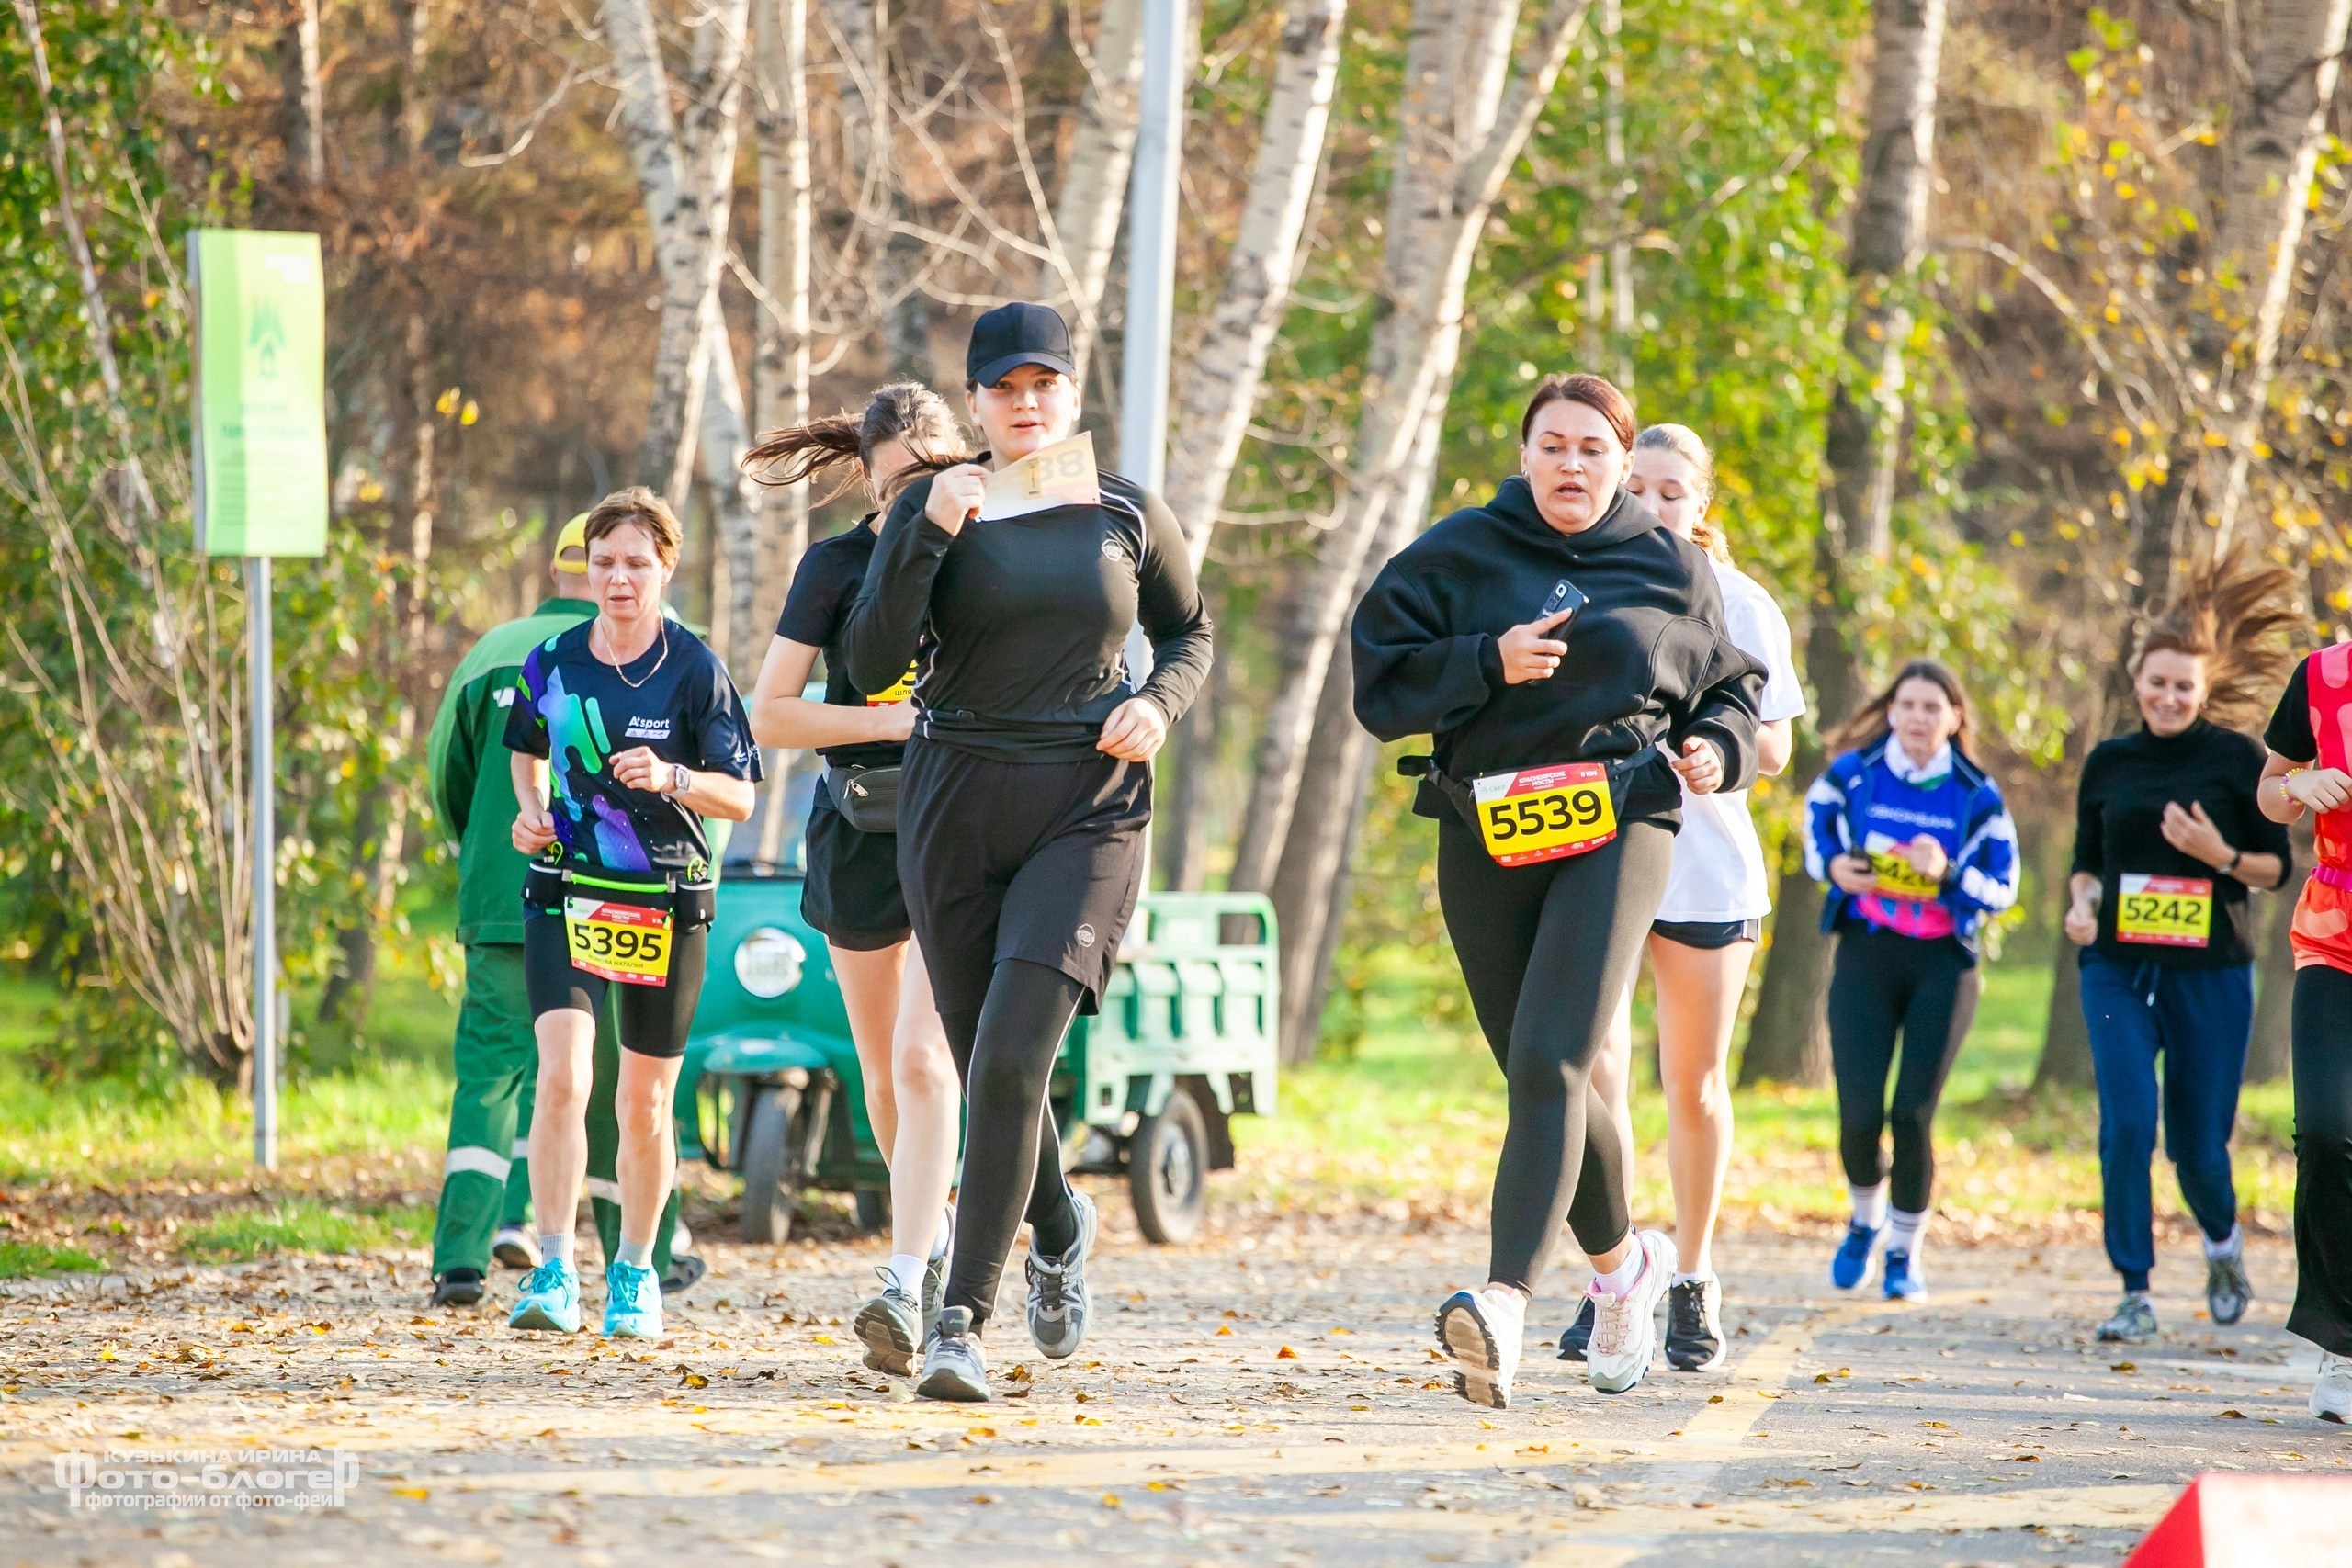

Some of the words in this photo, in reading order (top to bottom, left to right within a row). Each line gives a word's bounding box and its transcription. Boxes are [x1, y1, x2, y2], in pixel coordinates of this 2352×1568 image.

[1532, 778, 1555, 786] МОСТЫ
[1489, 790, 1602, 840] 5539
[2124, 897, 2201, 926] 5242
[573, 923, 662, 962] 5395
[614, 960, 644, 969] НАТАЛЬЯ
